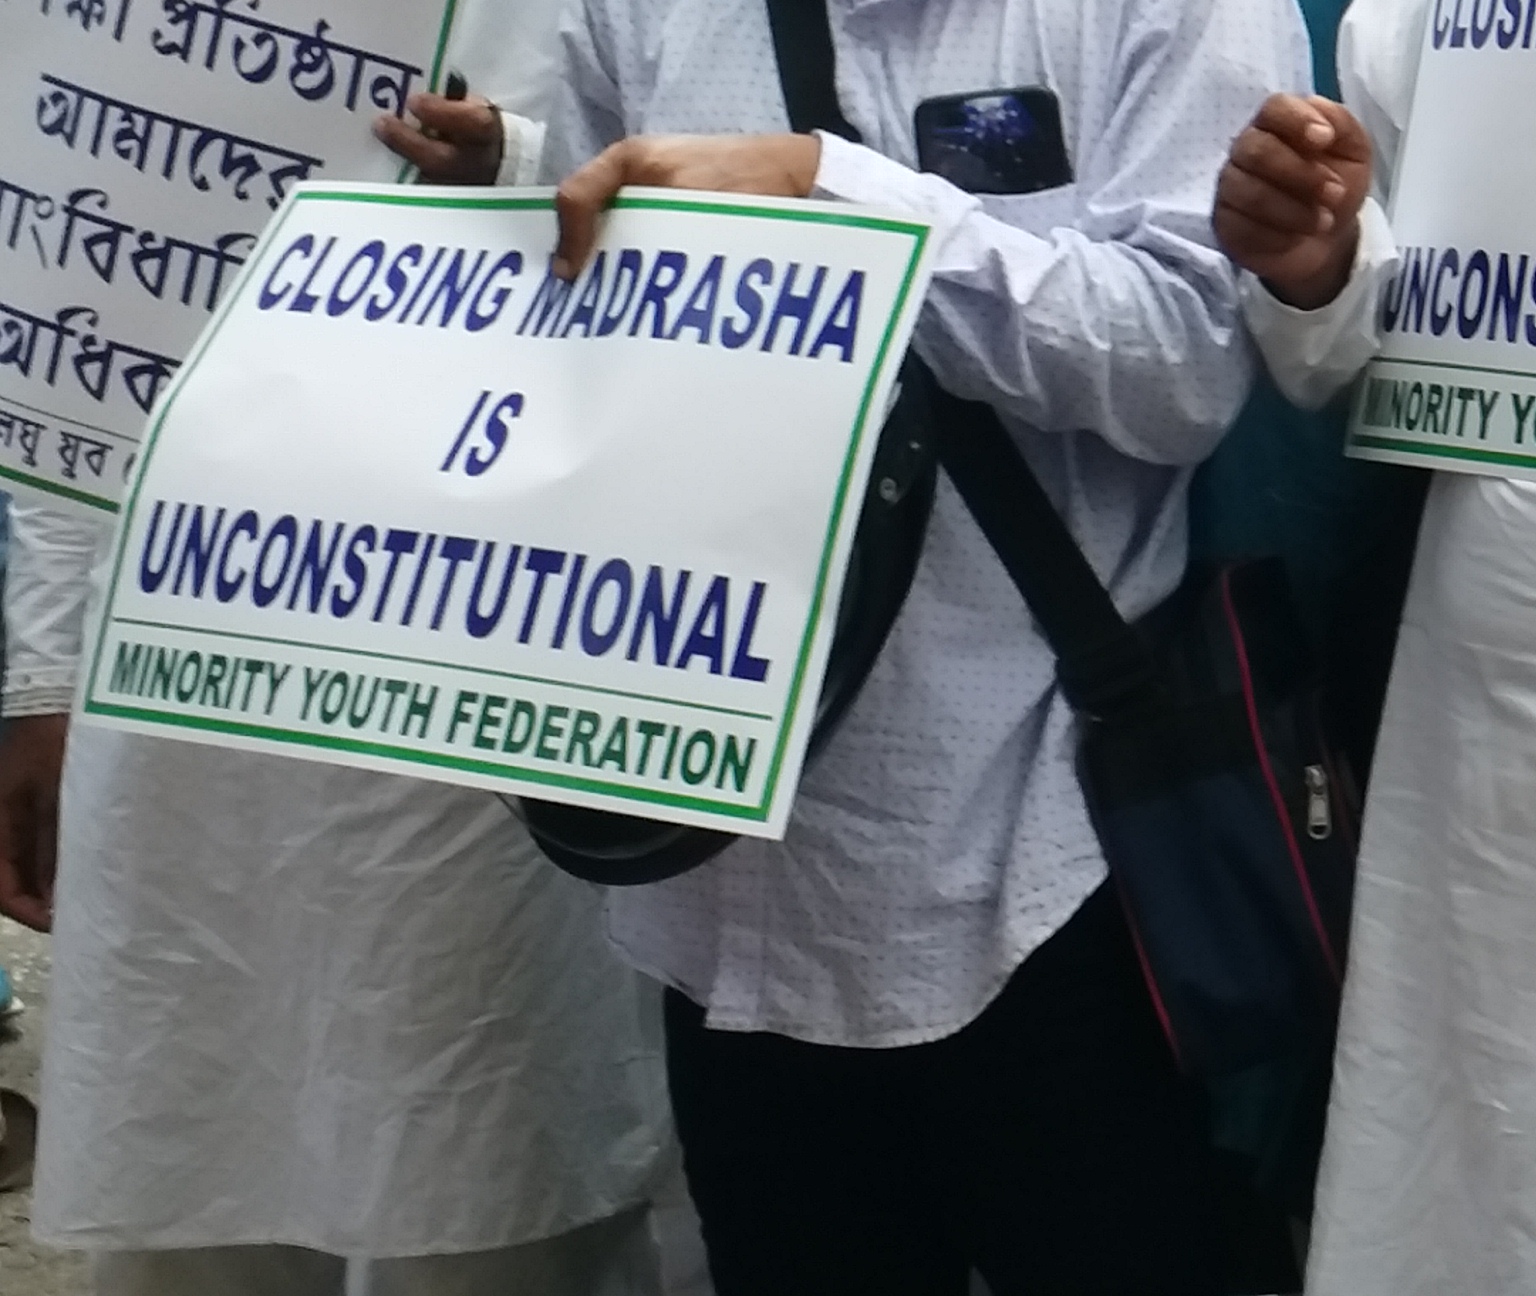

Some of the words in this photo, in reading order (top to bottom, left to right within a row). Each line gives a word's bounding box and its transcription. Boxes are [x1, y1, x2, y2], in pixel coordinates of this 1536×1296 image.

[257, 233, 523, 333] CLOSING
[518, 249, 866, 364] MADRASHA
[440, 390, 524, 477] IS
[138, 499, 774, 683] UNCONSTITUTIONAL
[110, 641, 293, 717] MINORITY
[300, 669, 440, 741] YOUTH
[445, 692, 757, 794] FEDERATION
